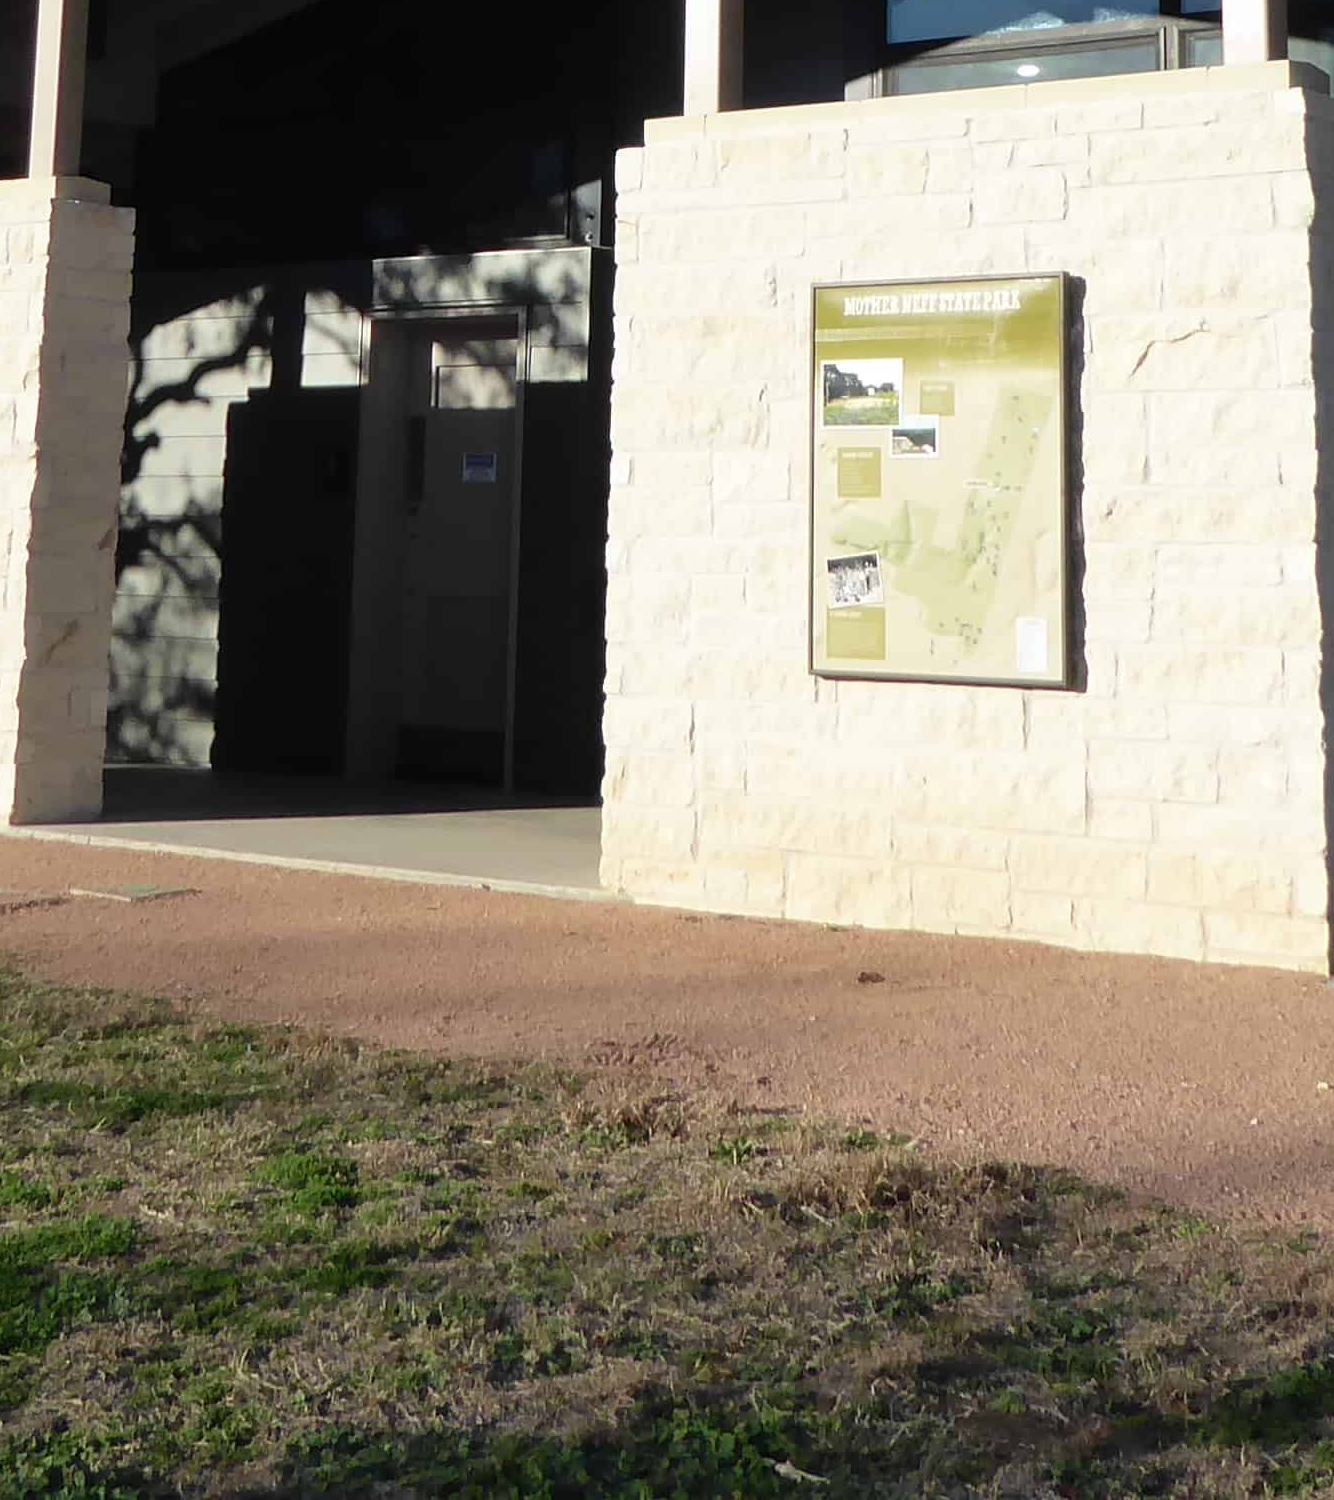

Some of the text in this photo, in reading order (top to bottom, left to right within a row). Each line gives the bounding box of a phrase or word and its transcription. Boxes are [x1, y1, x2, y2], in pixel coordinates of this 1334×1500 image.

[843, 294, 899, 316] MOTHER
[939, 290, 981, 312] STATE
[983, 289, 1021, 311] PARK
